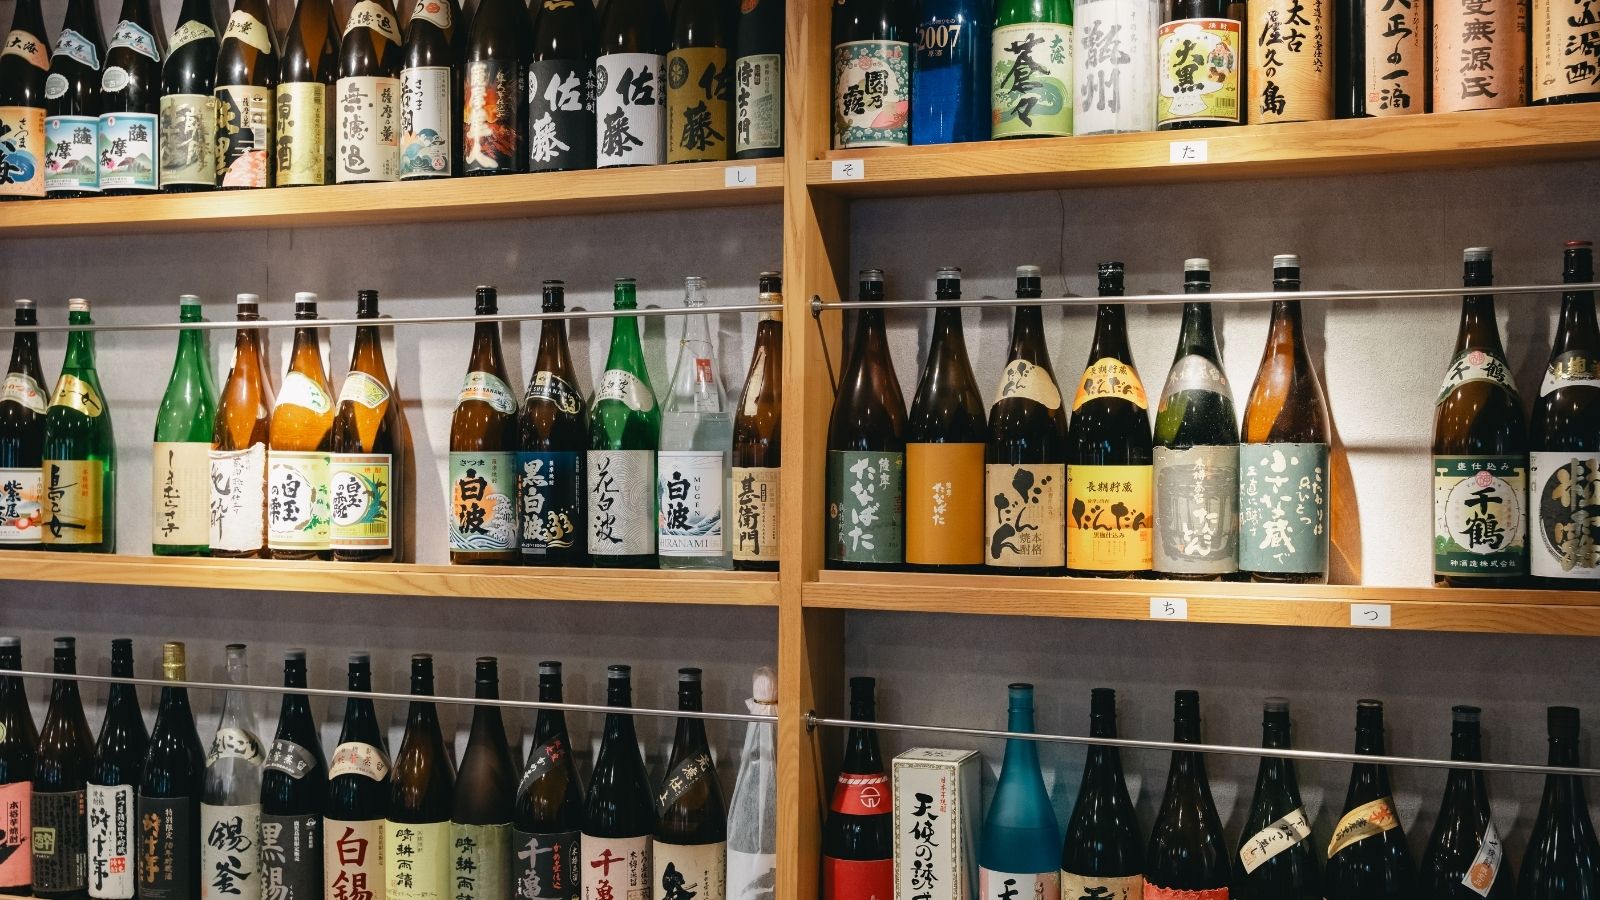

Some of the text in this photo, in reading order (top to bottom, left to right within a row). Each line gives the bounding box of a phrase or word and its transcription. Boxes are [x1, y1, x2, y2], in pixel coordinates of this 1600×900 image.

[918, 26, 963, 51] 2007
[1172, 39, 1205, 94] 大黒
[415, 79, 424, 111] さつま
[532, 71, 583, 163] 佐藤
[601, 66, 656, 157] 佐藤
[16, 117, 28, 149] さつま
[278, 93, 294, 171] 原酒
[341, 82, 373, 175] 無濾過
[1183, 146, 1196, 159] た
[738, 171, 747, 183] し
[1450, 357, 1504, 383] 千鶴
[281, 473, 300, 523] 白玉
[459, 468, 488, 541] 白波
[522, 459, 549, 541] 黒白波
[592, 457, 623, 544] 花白波
[667, 471, 692, 531] 白波
[850, 458, 879, 552] たなばた
[933, 482, 946, 526] たなばた
[1086, 481, 1133, 493] 長期貯蔵
[1459, 488, 1504, 550] 千鶴
[1163, 601, 1175, 615] ち
[1364, 610, 1378, 621] つ
